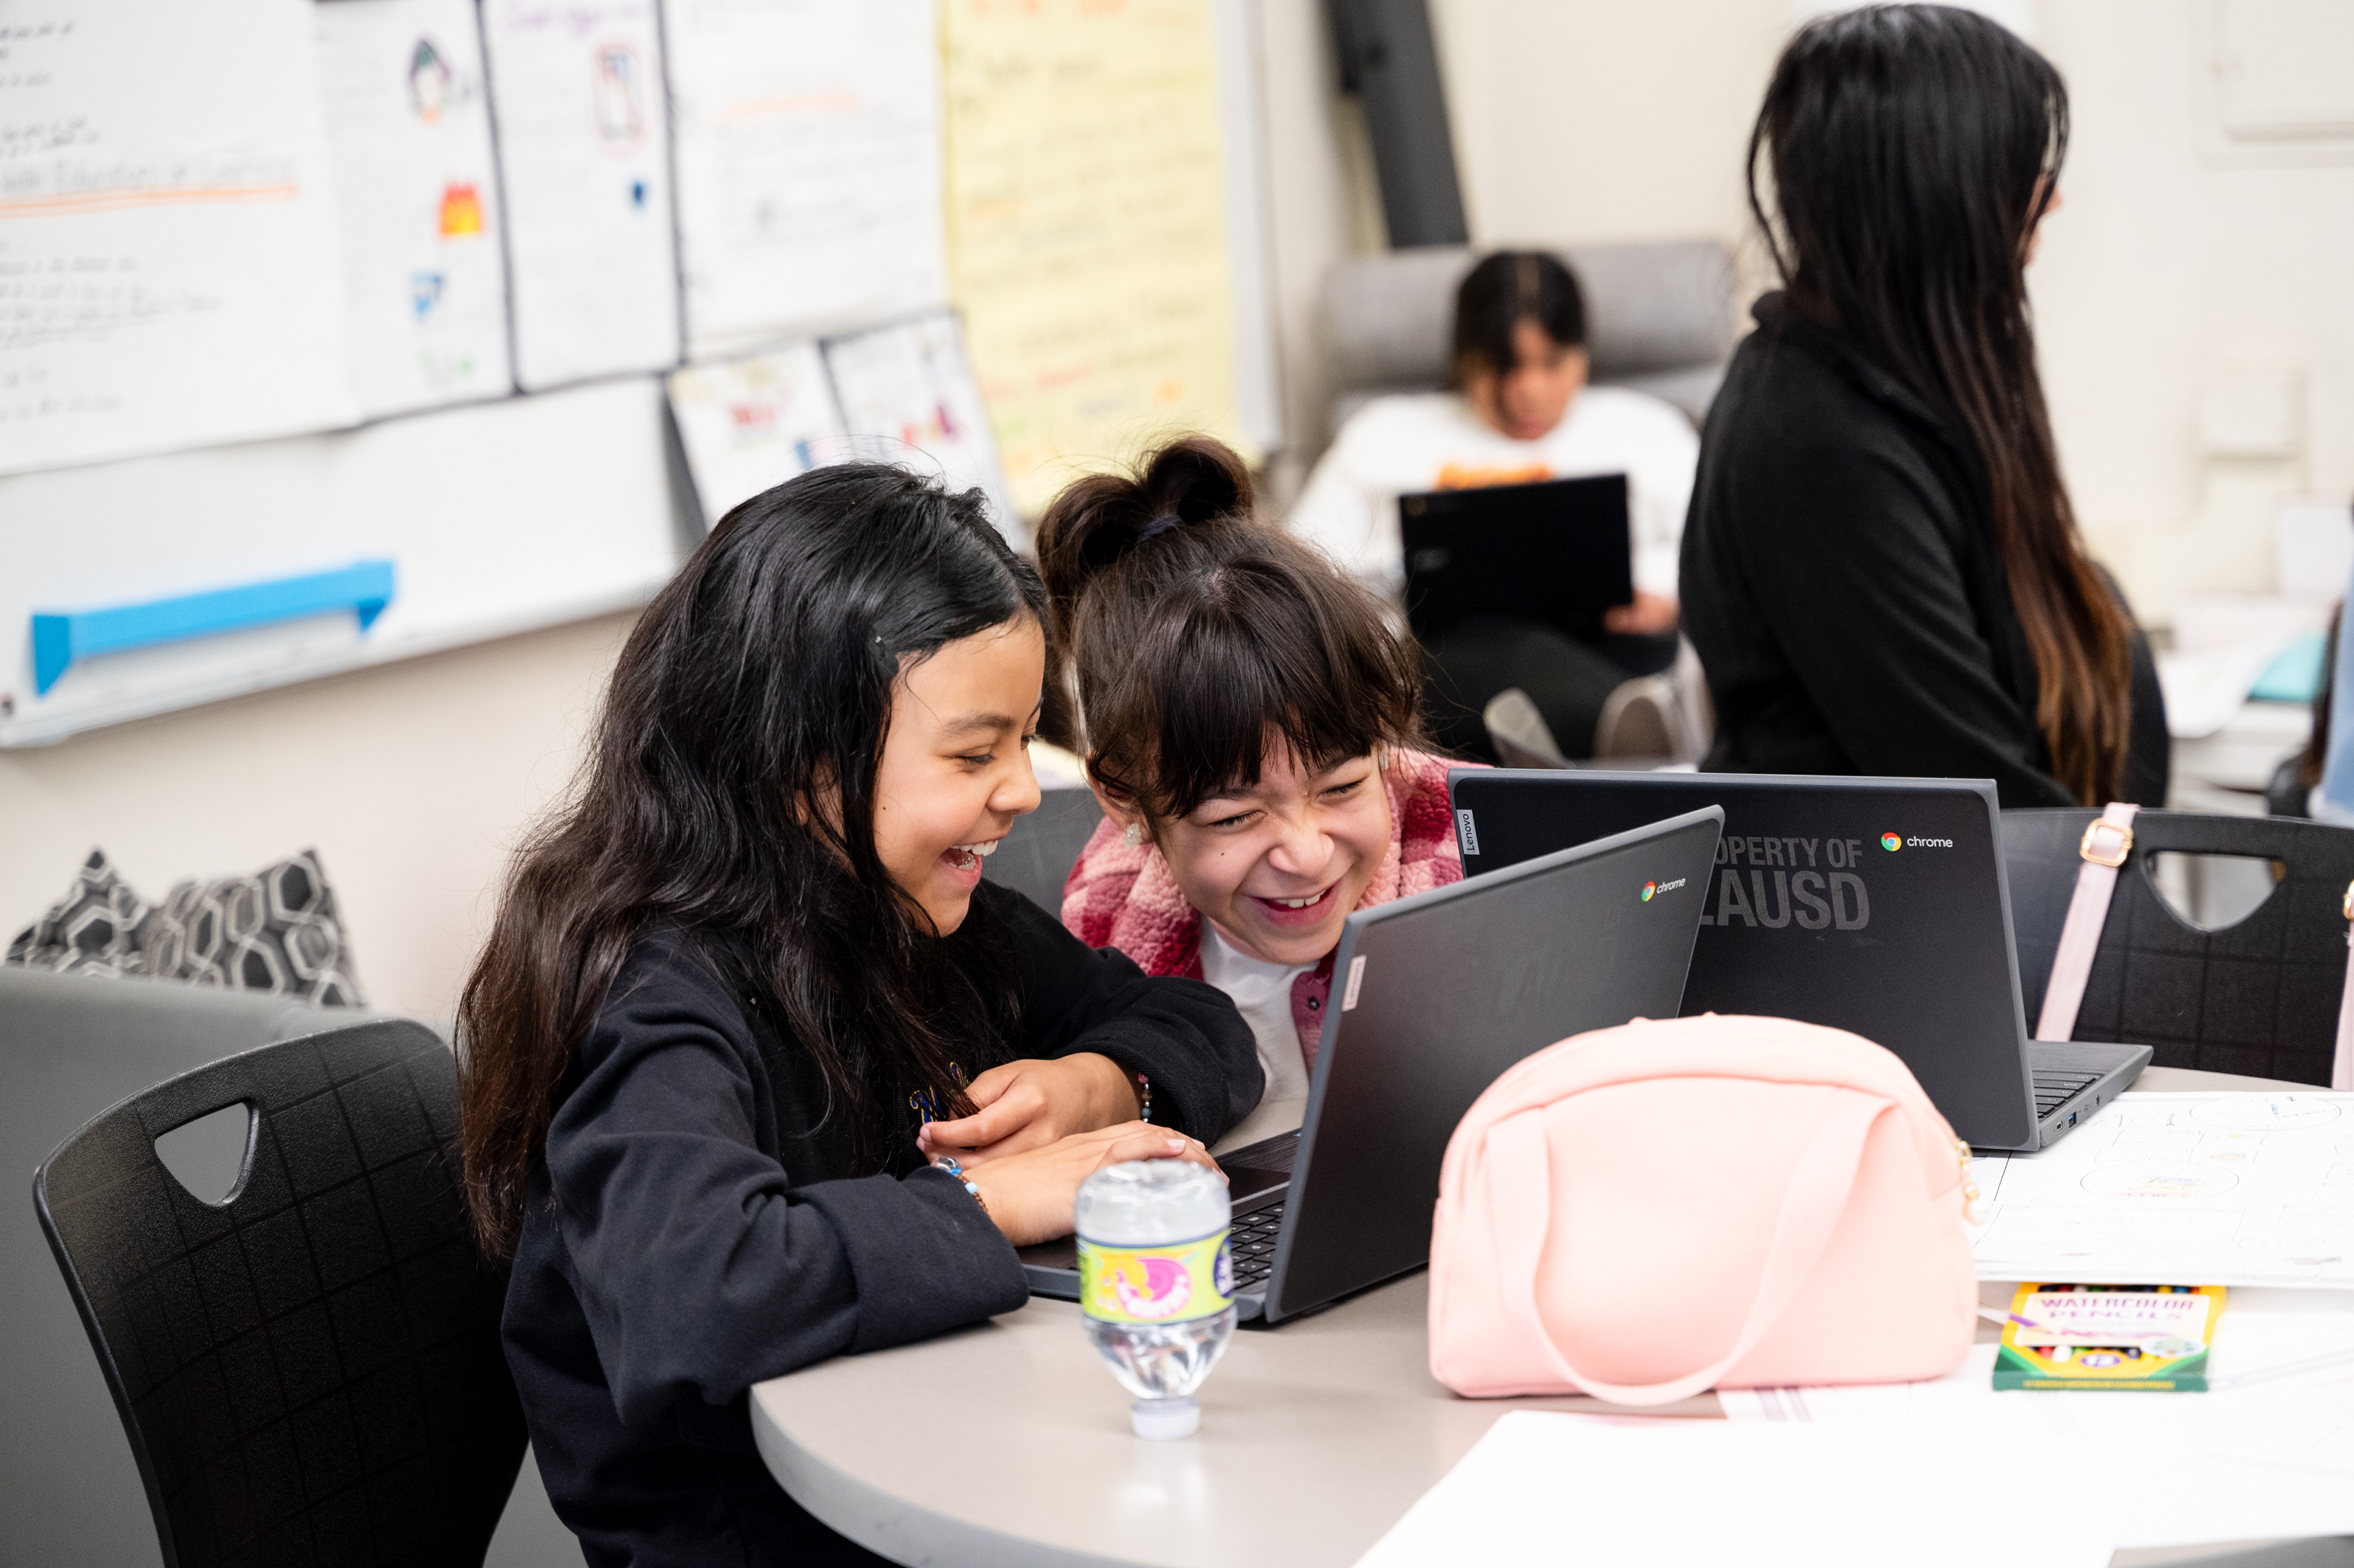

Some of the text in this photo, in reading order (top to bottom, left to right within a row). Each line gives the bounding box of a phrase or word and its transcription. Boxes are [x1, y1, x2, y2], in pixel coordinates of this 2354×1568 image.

[1463, 813, 1475, 851] Lenovo
[1906, 835, 1953, 848] chrome
[1714, 835, 1862, 868] OPERTY OF
[1656, 878, 1686, 894] chrome
[2041, 1298, 2195, 1310] WATERCOLOR
[2049, 1311, 2183, 1320] PENCILS
